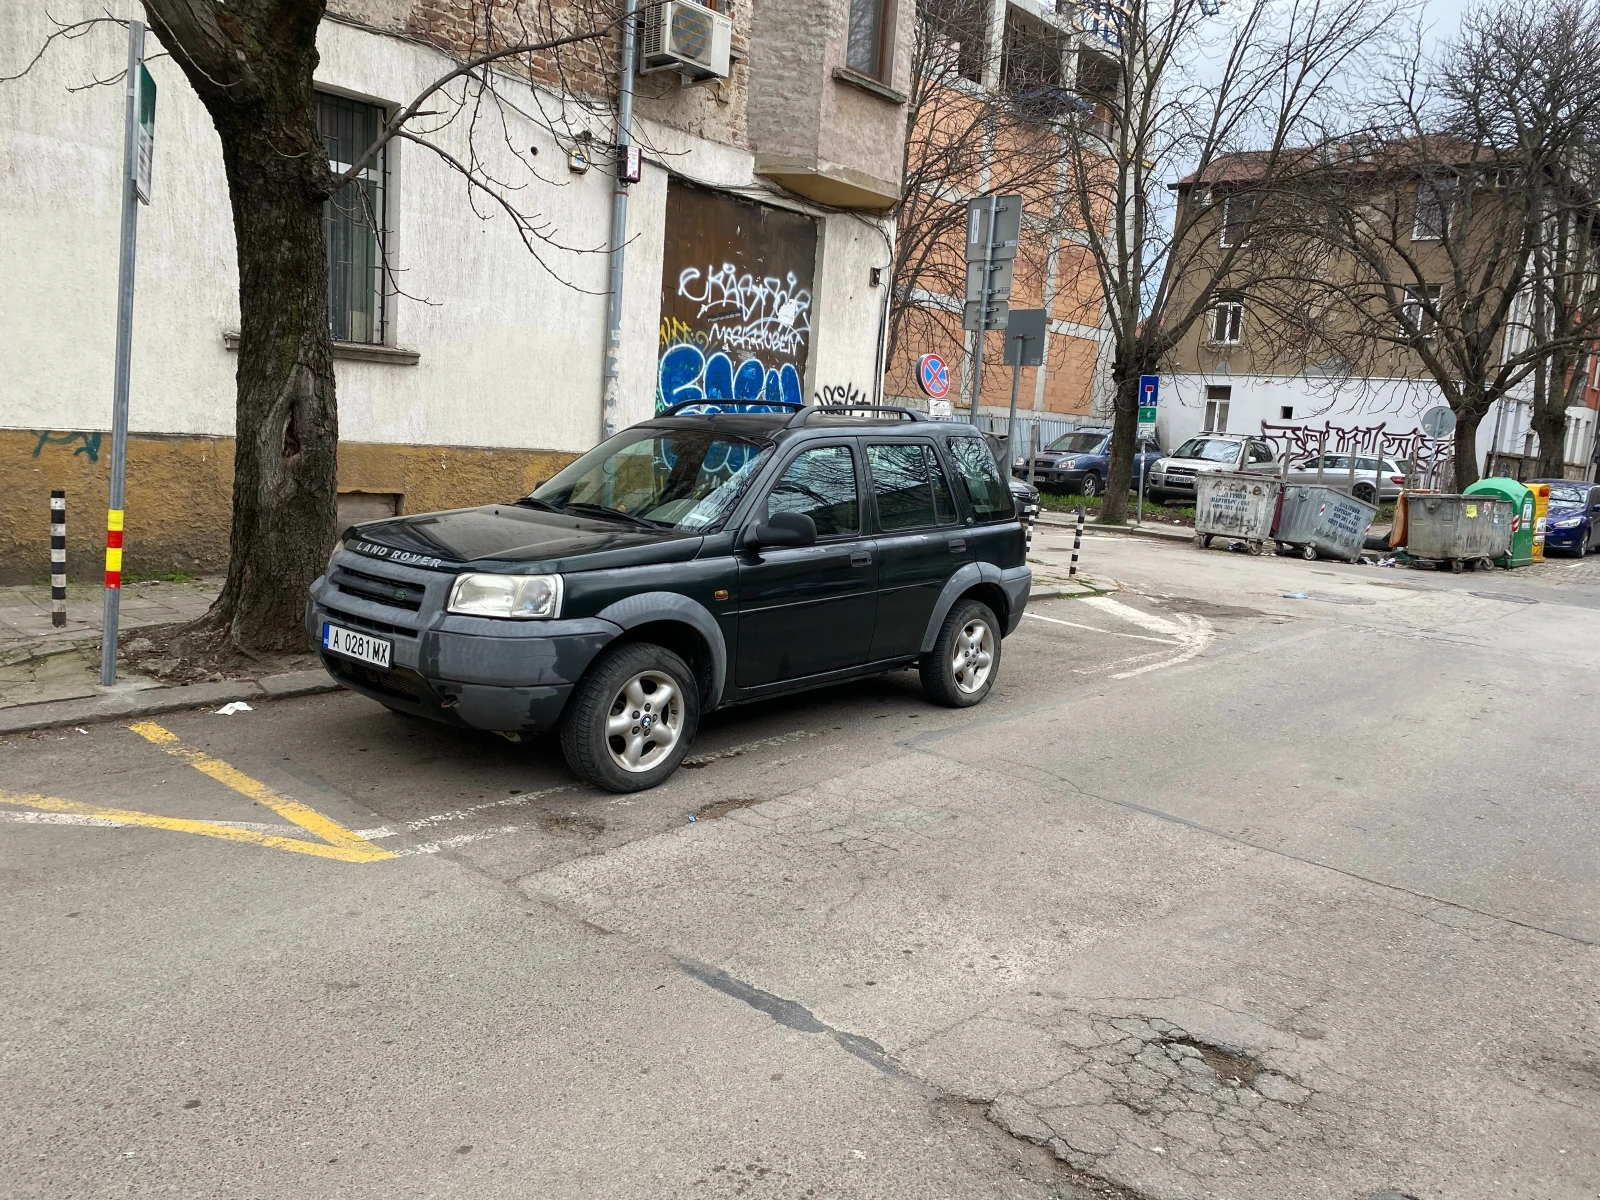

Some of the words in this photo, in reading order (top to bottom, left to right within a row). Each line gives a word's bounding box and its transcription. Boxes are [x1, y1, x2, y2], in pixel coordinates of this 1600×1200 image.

[356, 541, 388, 557] LAND
[390, 549, 442, 569] ROVER
[332, 629, 340, 649] A
